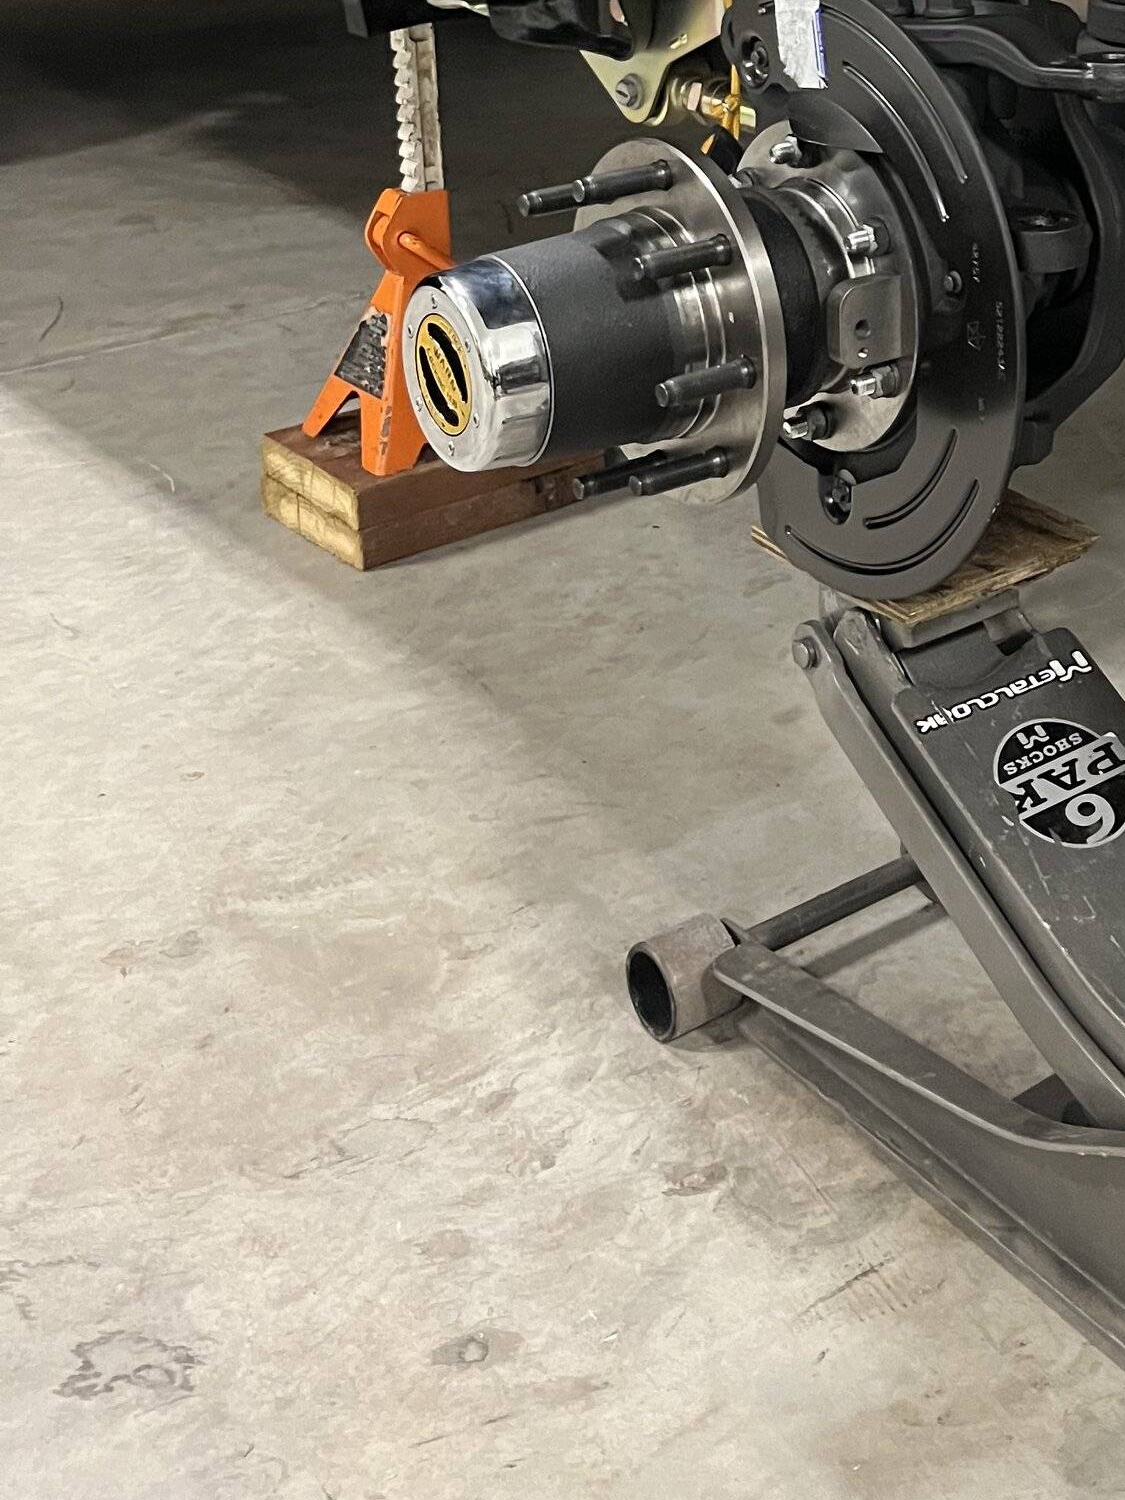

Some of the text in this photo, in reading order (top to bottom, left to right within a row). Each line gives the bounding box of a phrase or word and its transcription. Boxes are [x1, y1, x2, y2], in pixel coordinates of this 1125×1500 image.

[432, 347, 456, 391] WARN
[1003, 732, 1083, 775] SHOCKS
[1065, 793, 1116, 845] 6
